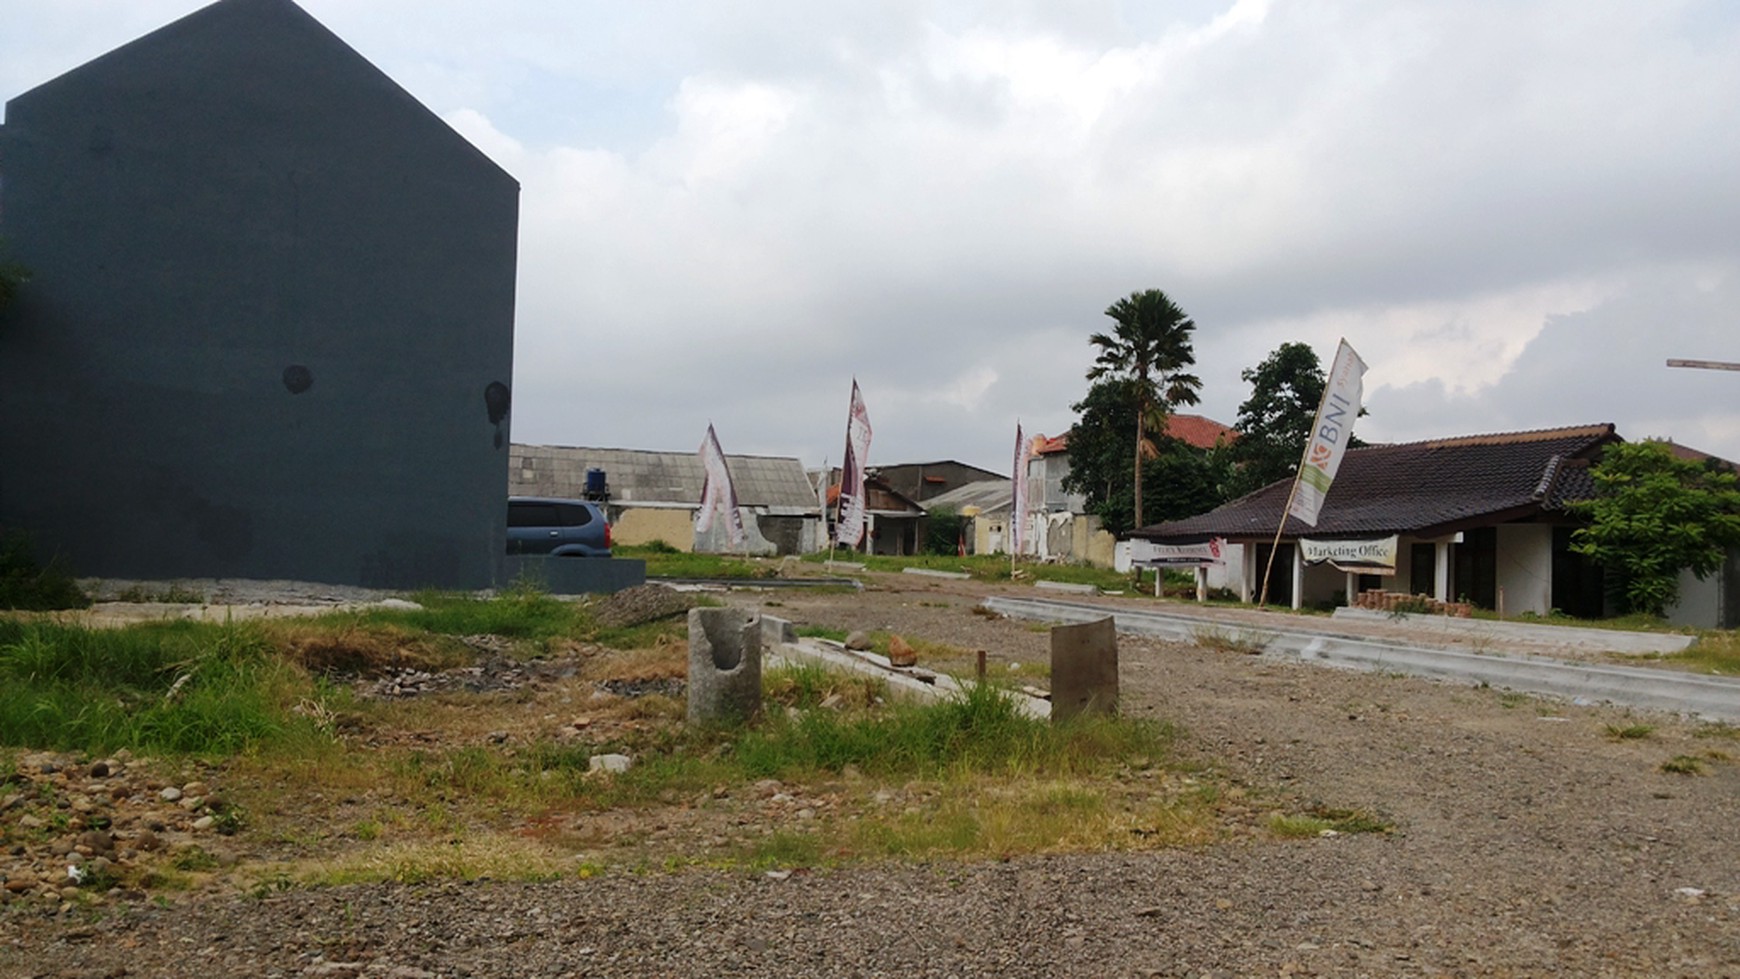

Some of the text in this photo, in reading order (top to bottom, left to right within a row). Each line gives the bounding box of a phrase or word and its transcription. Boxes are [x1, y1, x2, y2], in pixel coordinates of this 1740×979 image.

[1319, 393, 1350, 444] BNI
[1308, 545, 1389, 558] Marketing Office
